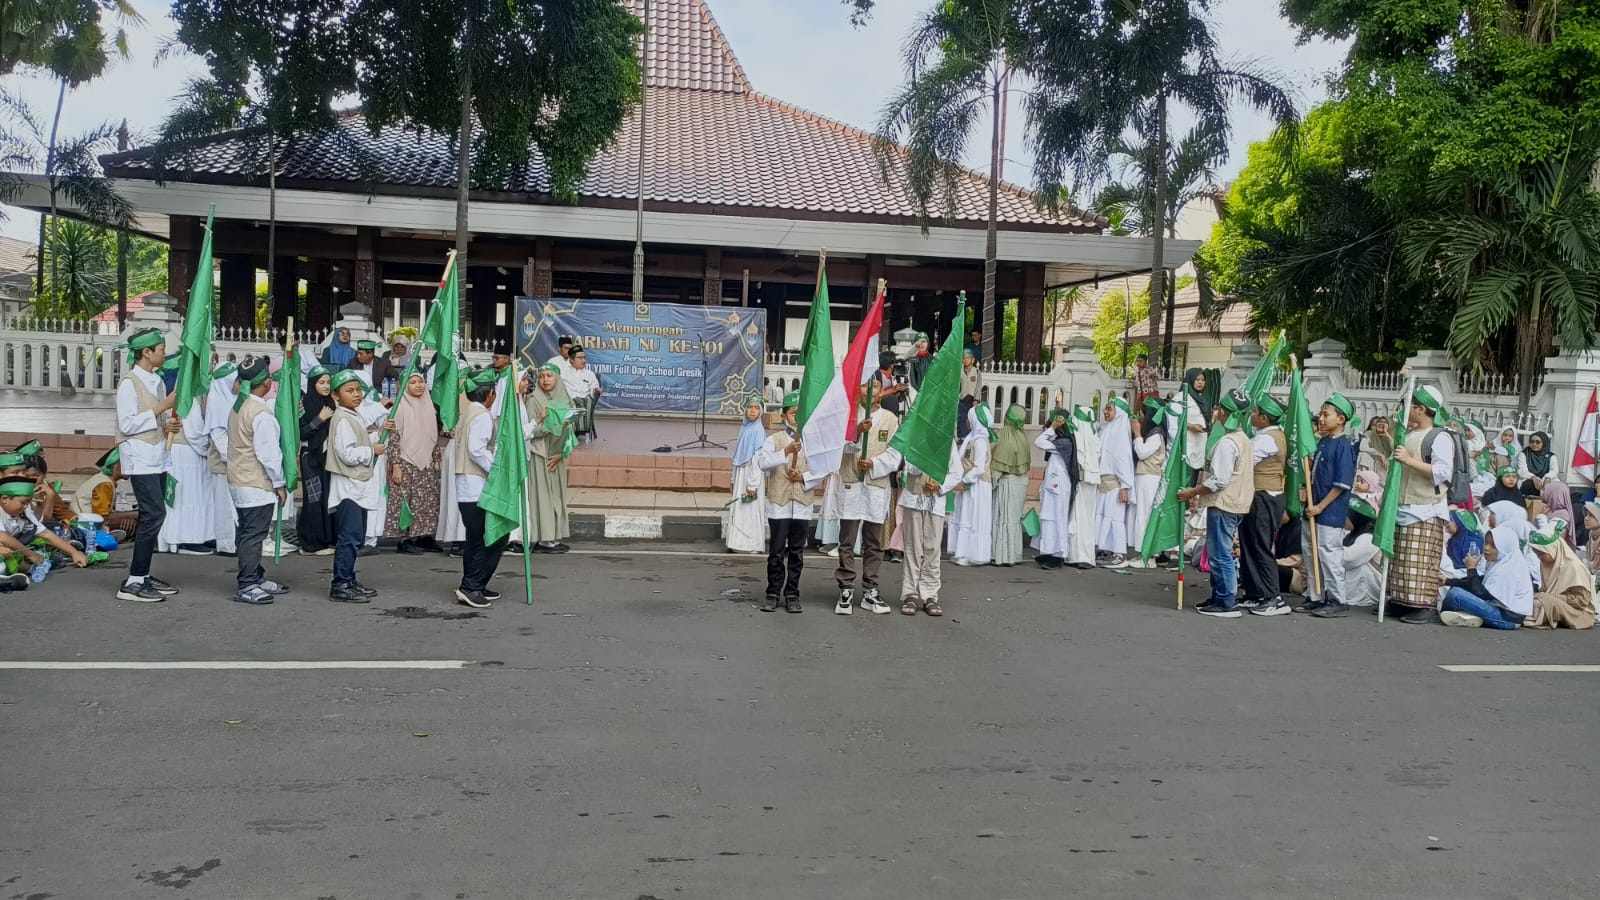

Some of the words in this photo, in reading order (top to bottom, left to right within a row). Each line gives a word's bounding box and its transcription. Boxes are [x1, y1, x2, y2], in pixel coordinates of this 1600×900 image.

[603, 320, 684, 337] Memperingati
[560, 334, 630, 351] ARLAH
[639, 337, 661, 352] NU
[593, 363, 612, 374] YIMI
[614, 364, 629, 375] Full
[631, 365, 647, 377] Day
[648, 366, 675, 377] School
[677, 367, 703, 378] Gresik
